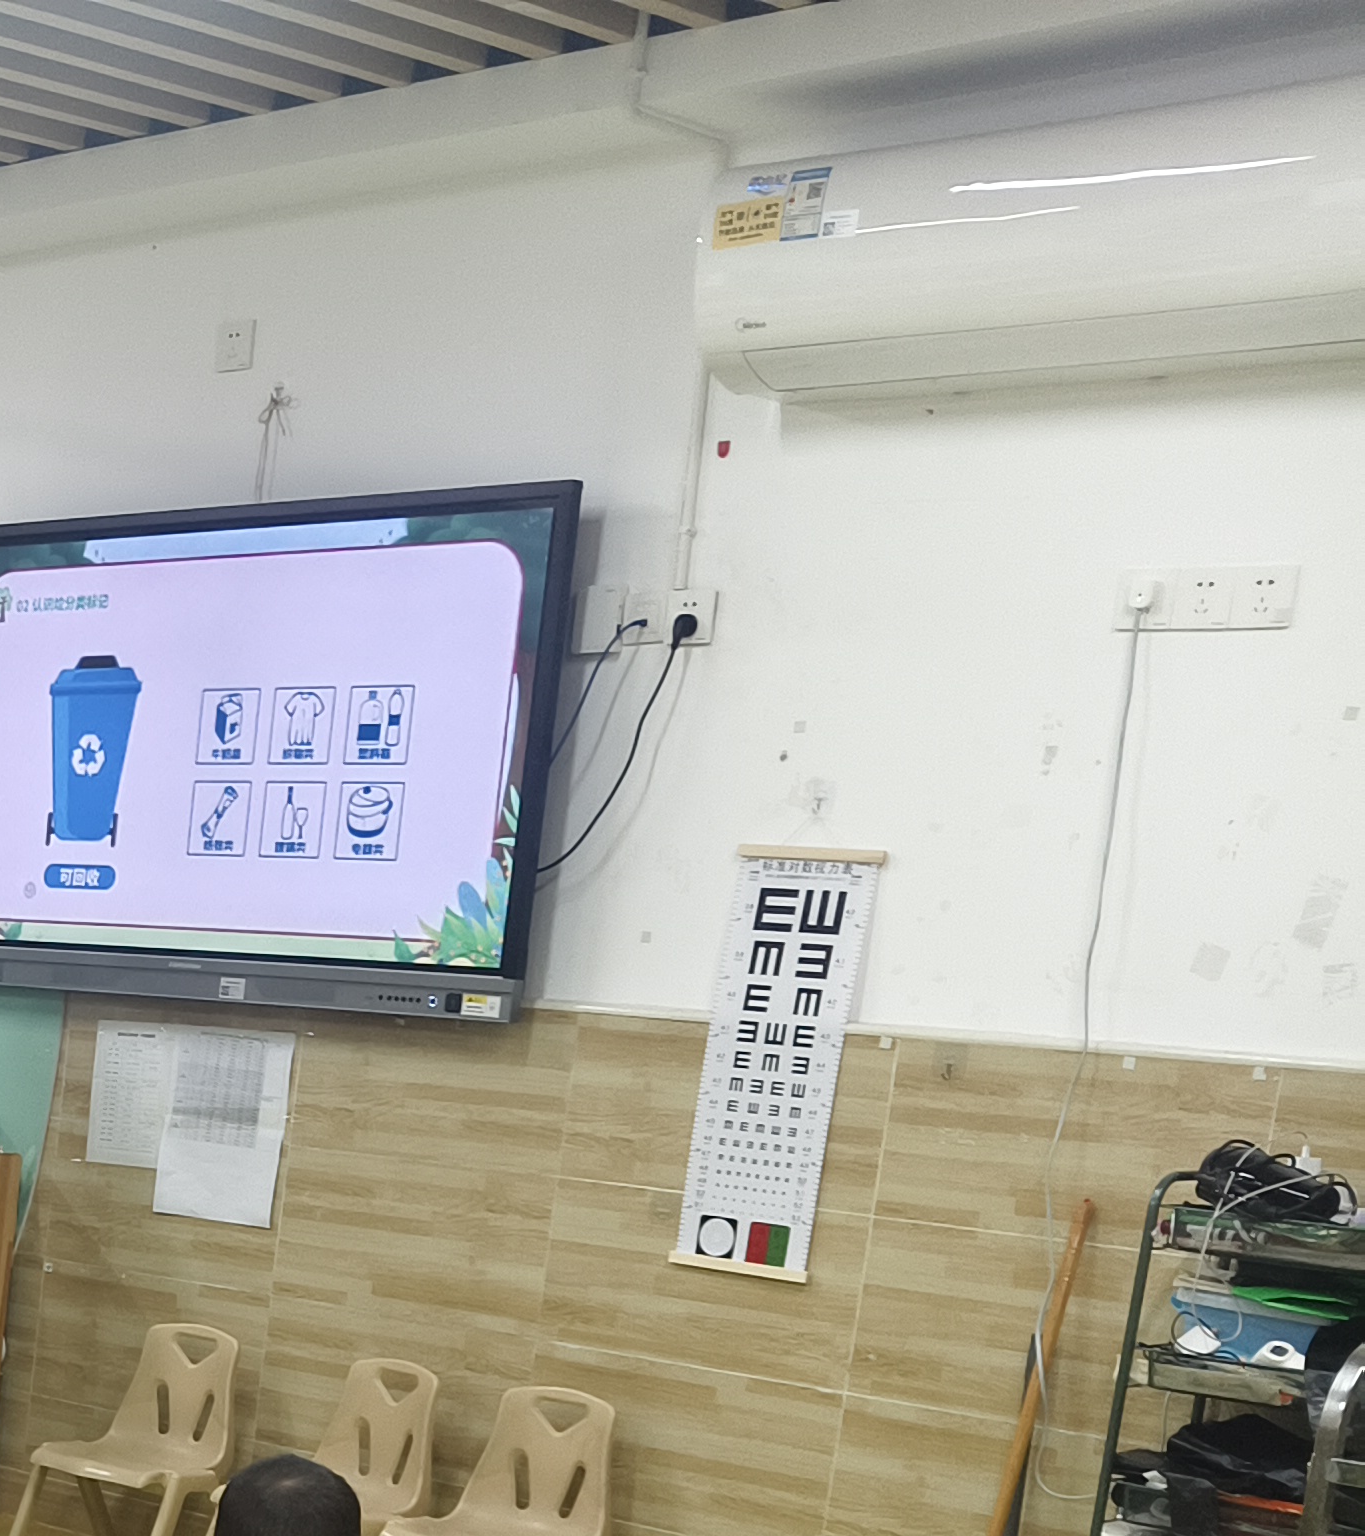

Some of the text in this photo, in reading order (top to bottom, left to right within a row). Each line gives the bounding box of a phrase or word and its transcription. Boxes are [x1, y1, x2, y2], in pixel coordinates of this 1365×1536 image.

[16, 599, 29, 612] 02
[60, 867, 100, 887] 可回收
